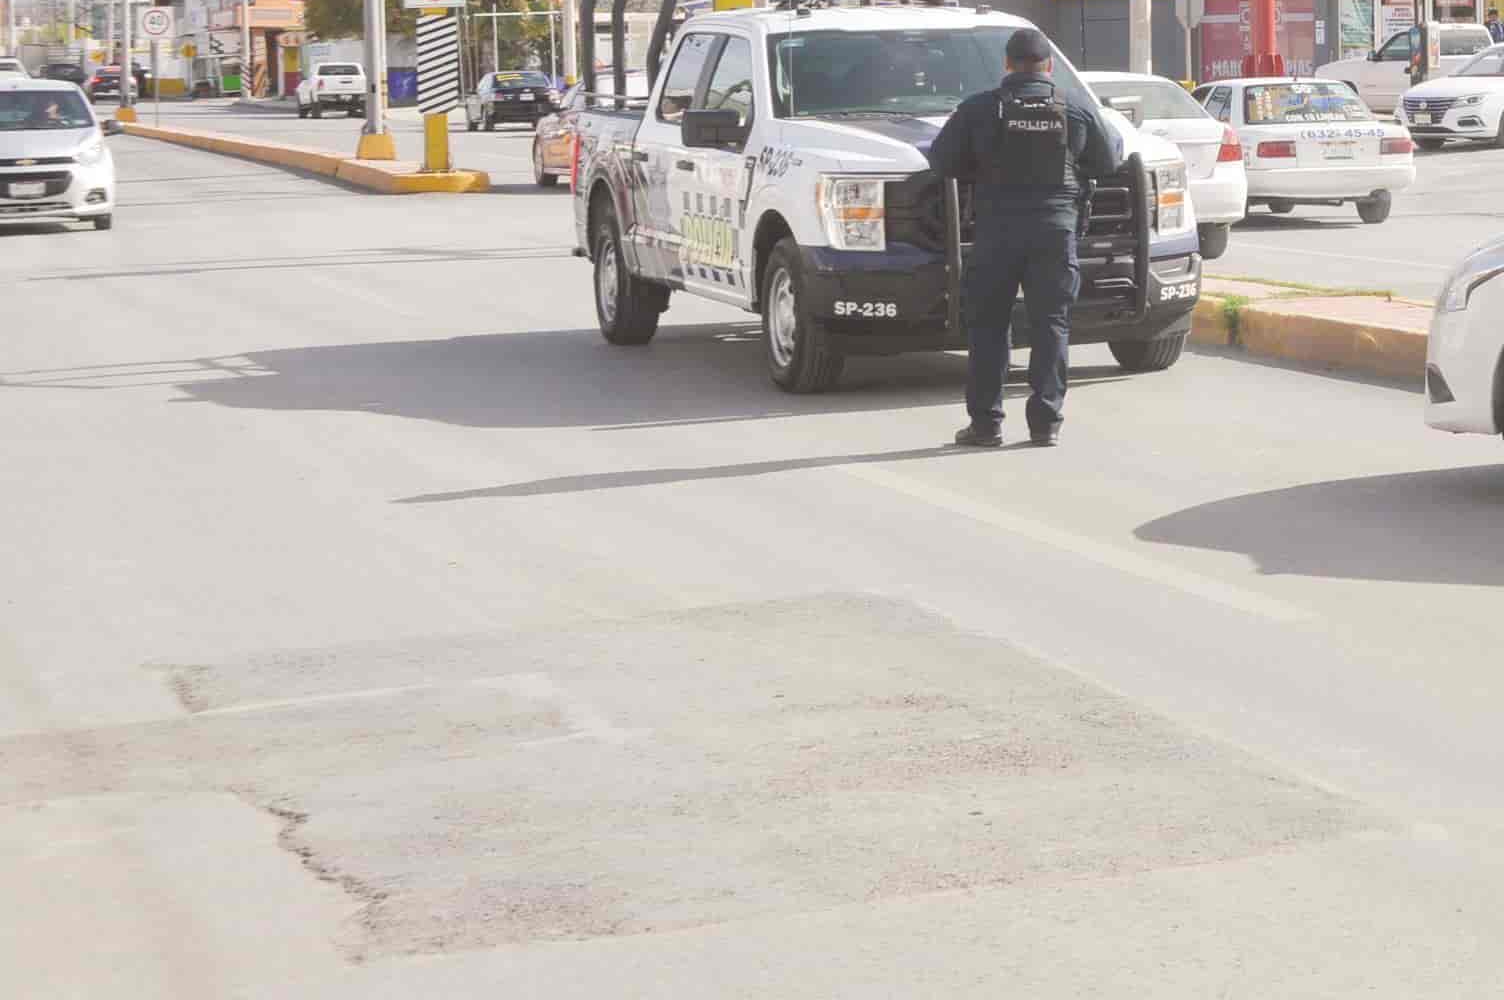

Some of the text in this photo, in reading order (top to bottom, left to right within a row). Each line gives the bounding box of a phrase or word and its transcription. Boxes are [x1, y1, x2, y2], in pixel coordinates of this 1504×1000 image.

[1007, 119, 1063, 131] POLICIA
[1160, 282, 1197, 301] SP-236
[833, 301, 898, 318] SP-236
